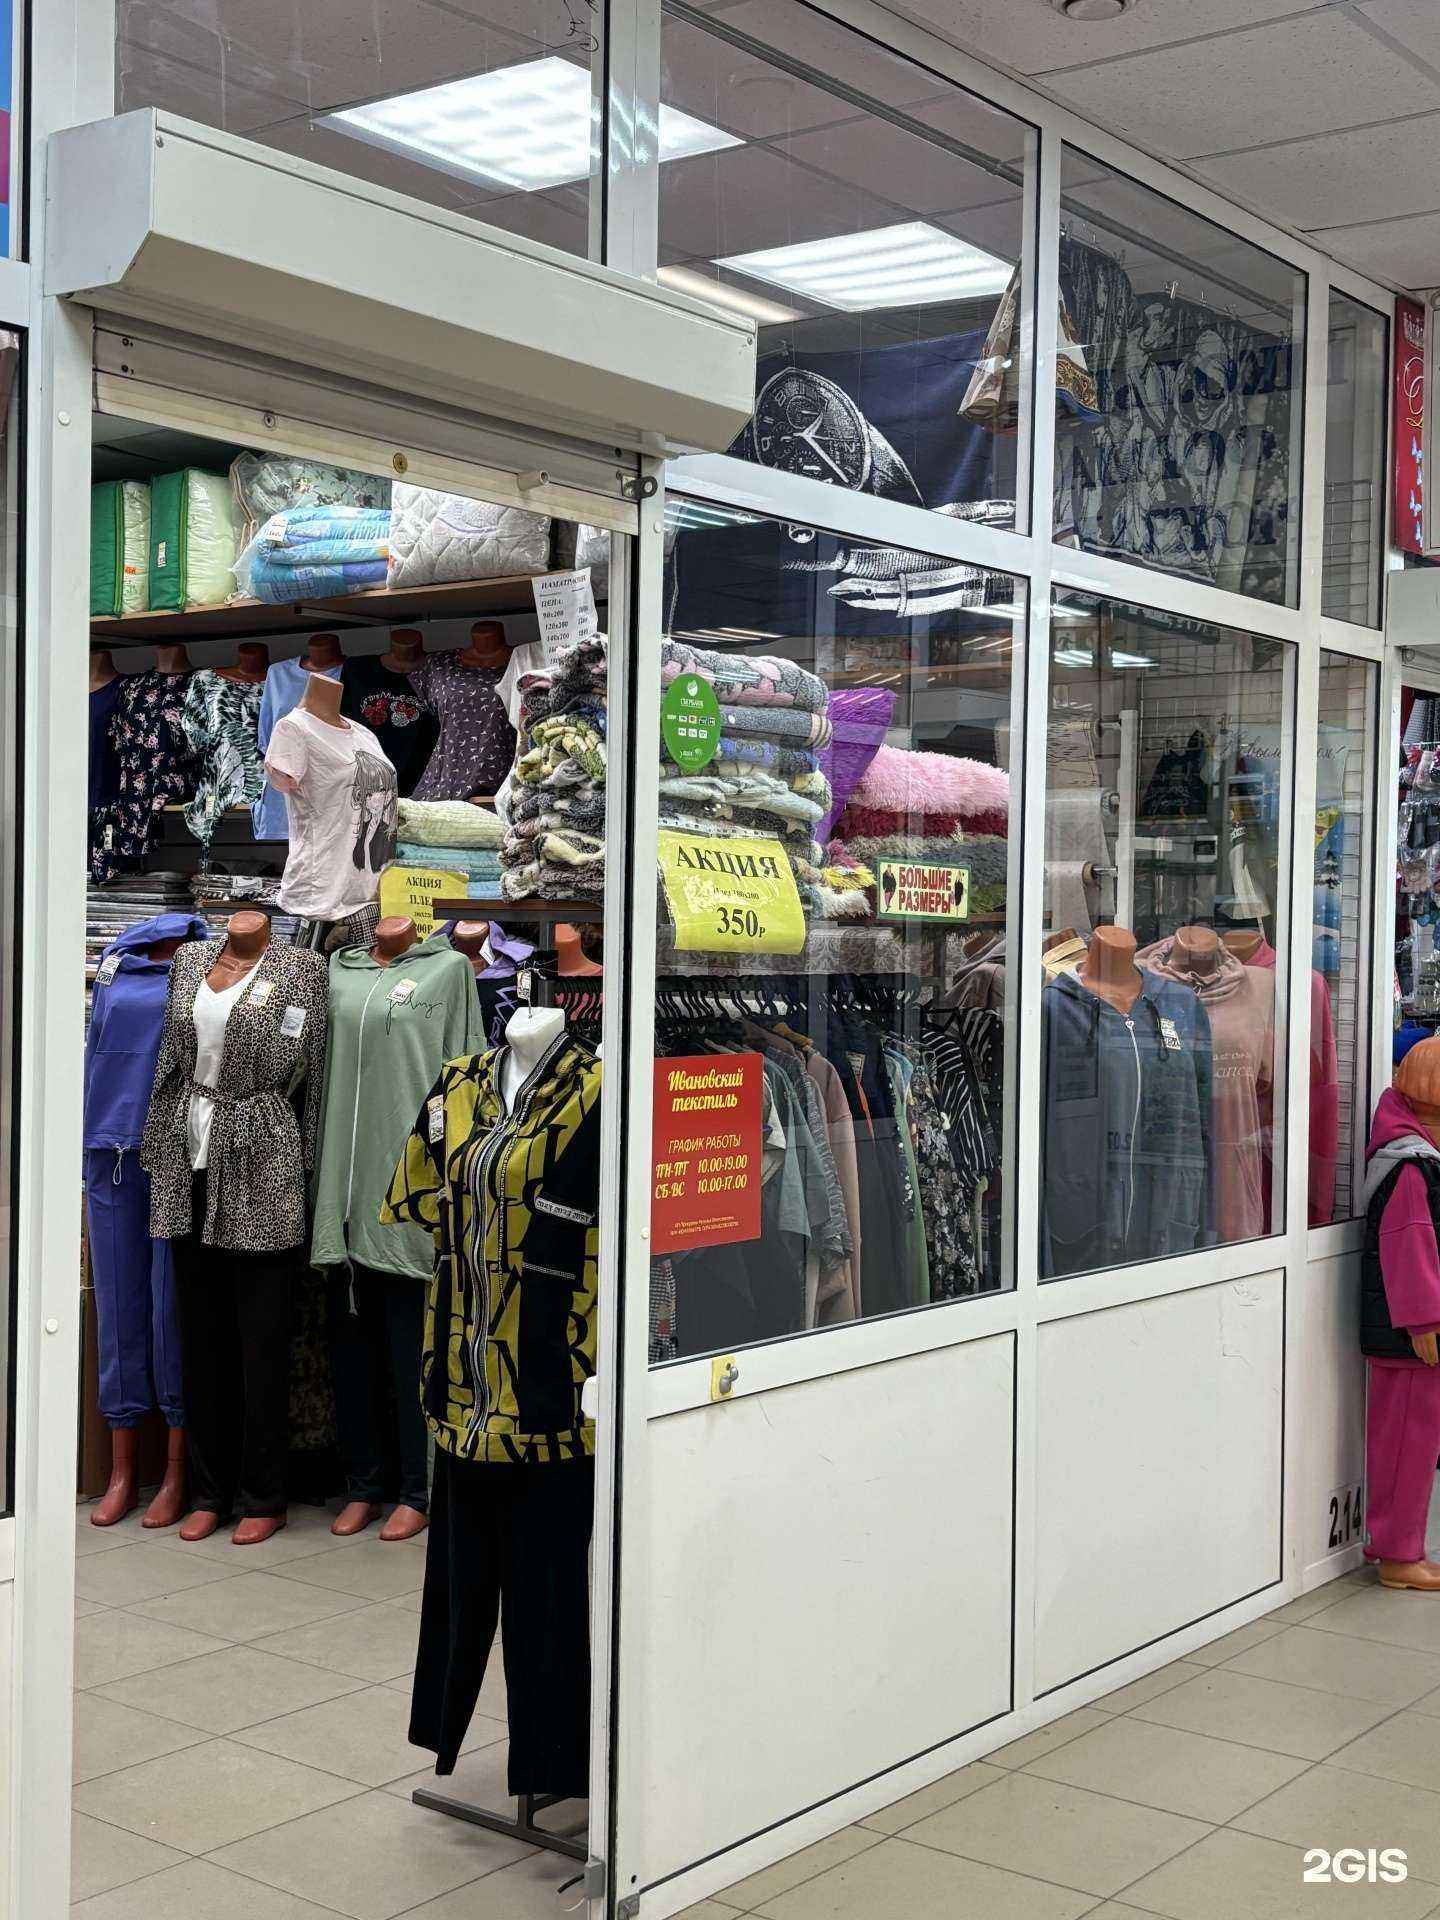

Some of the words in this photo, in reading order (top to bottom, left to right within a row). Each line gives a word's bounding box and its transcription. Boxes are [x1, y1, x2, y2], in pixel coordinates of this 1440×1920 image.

[676, 844, 783, 881] АКЦИЯ
[406, 876, 442, 889] АКЦИЯ
[898, 866, 952, 892] БОЛЬШИЕ
[898, 889, 952, 914] РАЗМЕРЫ
[667, 1067, 744, 1092] Ивановский
[671, 1093, 738, 1112] текстиль
[668, 1138, 704, 1154] ГРАФИК
[705, 1133, 742, 1151] РАБОТЫ
[655, 1160, 690, 1179] ПН-ПТ
[697, 1154, 748, 1174] 10.00-19.00
[654, 1181, 686, 1200] СБ-ВС
[697, 1174, 748, 1194] 10.00-17.00
[1328, 1486, 1362, 1549] 2.14
